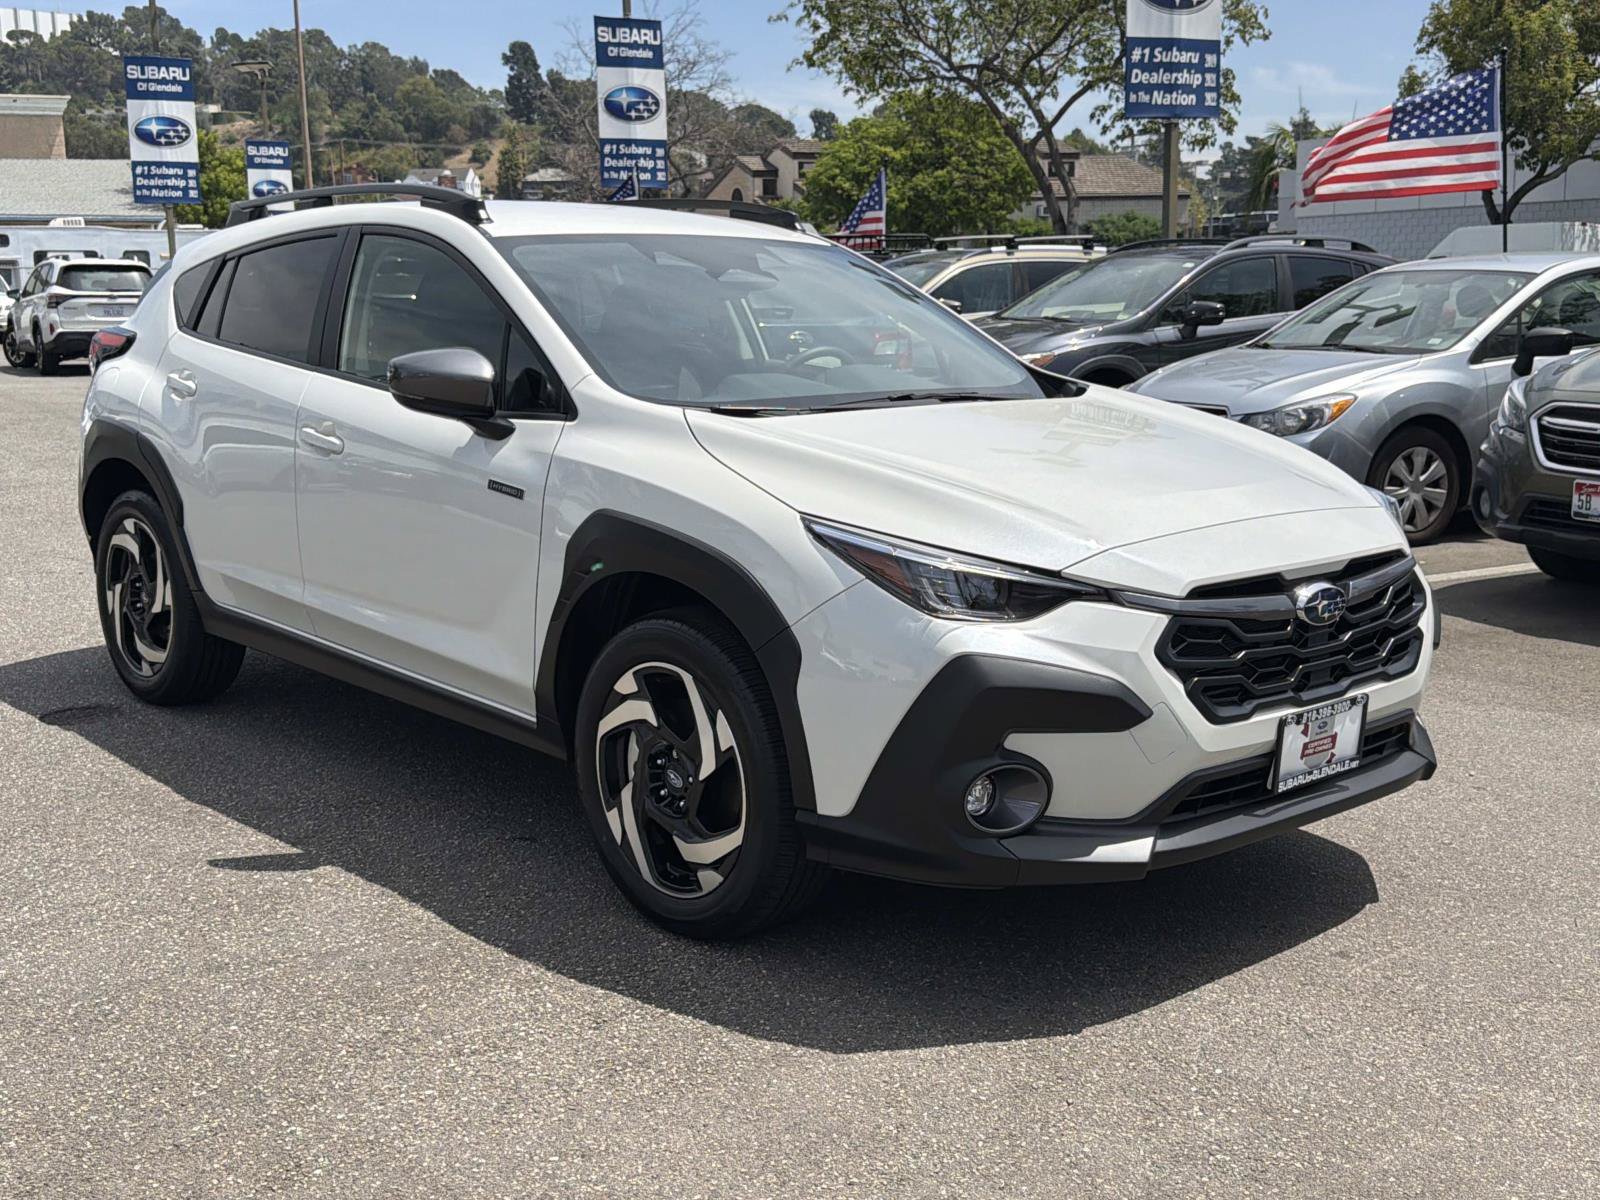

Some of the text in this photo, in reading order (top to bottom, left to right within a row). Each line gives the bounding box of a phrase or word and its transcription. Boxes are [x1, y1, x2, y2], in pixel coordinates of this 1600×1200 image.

[597, 26, 661, 46] SUBARU
[608, 46, 654, 59] Of Glendale
[1130, 47, 1150, 63] #1
[1153, 46, 1200, 64] Subaru
[126, 64, 190, 81] SUBARU
[1130, 68, 1203, 89] Dealership
[137, 82, 183, 93] Of Glendale
[1129, 91, 1137, 103] In
[1138, 90, 1150, 103] The
[1151, 89, 1197, 106] Nation
[247, 145, 289, 157] SUBARU
[603, 143, 653, 155] #1 Subaru
[135, 165, 184, 175] #1 Subaru
[604, 157, 655, 170] Dealerhip
[136, 177, 187, 188] Dealership
[151, 188, 183, 198] Nation
